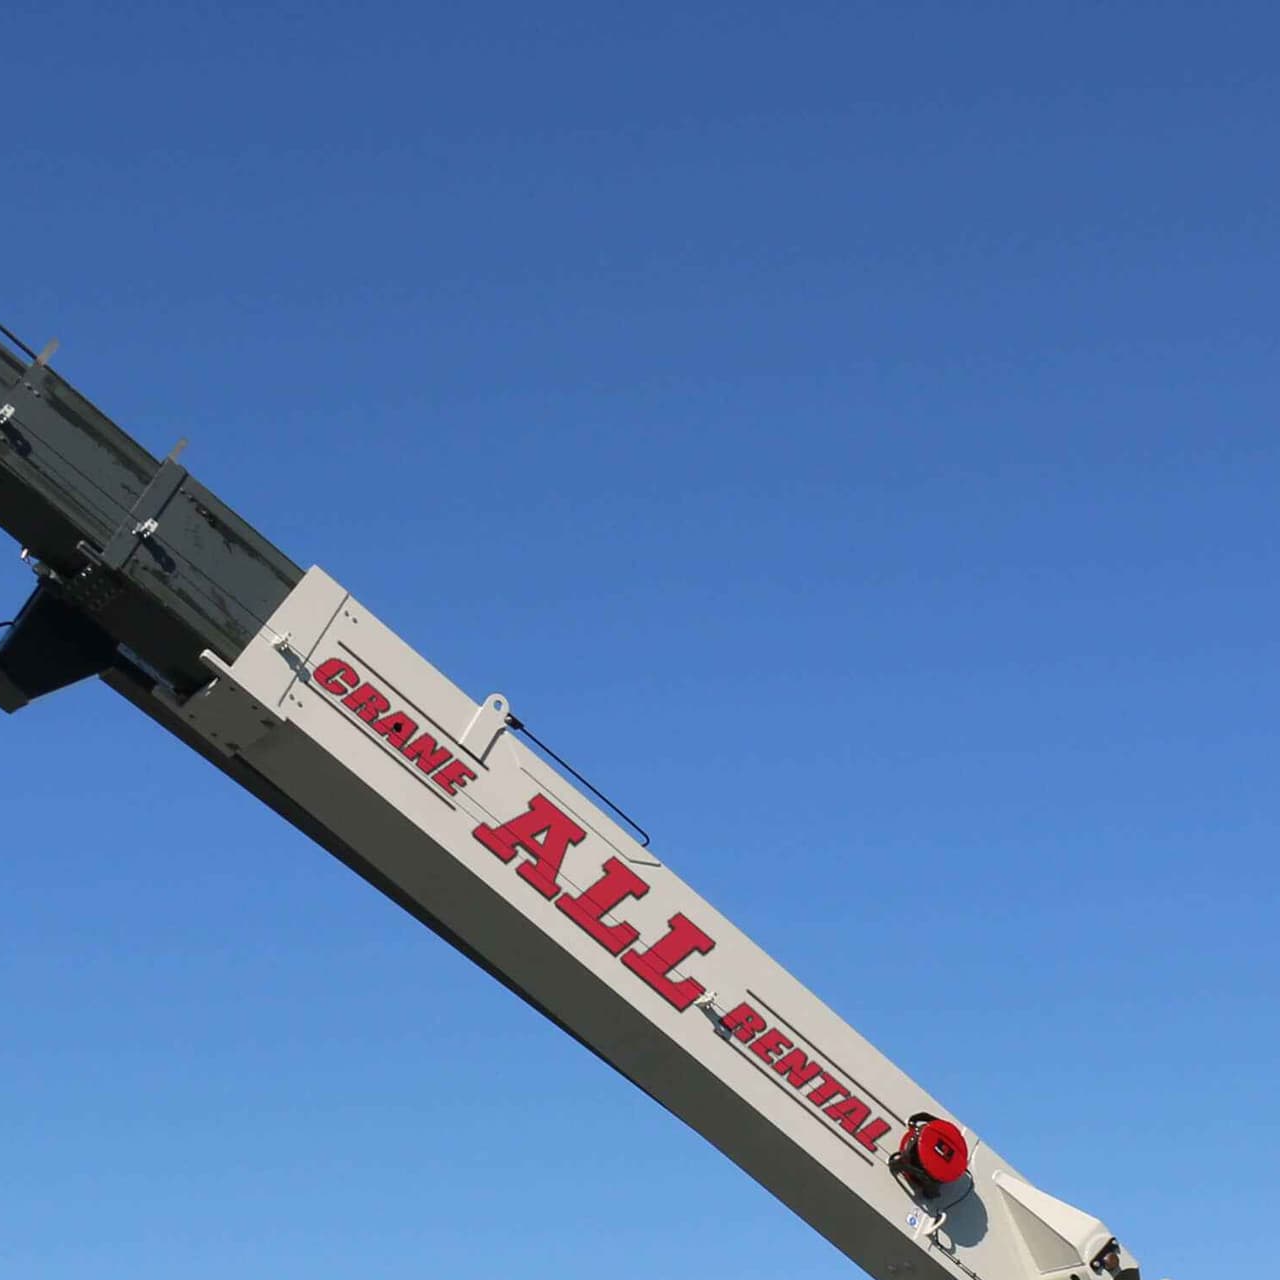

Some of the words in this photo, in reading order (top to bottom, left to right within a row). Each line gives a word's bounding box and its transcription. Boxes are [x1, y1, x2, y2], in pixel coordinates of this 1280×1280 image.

[313, 658, 478, 796] CRANE
[472, 793, 716, 1013] ALL
[721, 1002, 892, 1153] RENTAL
